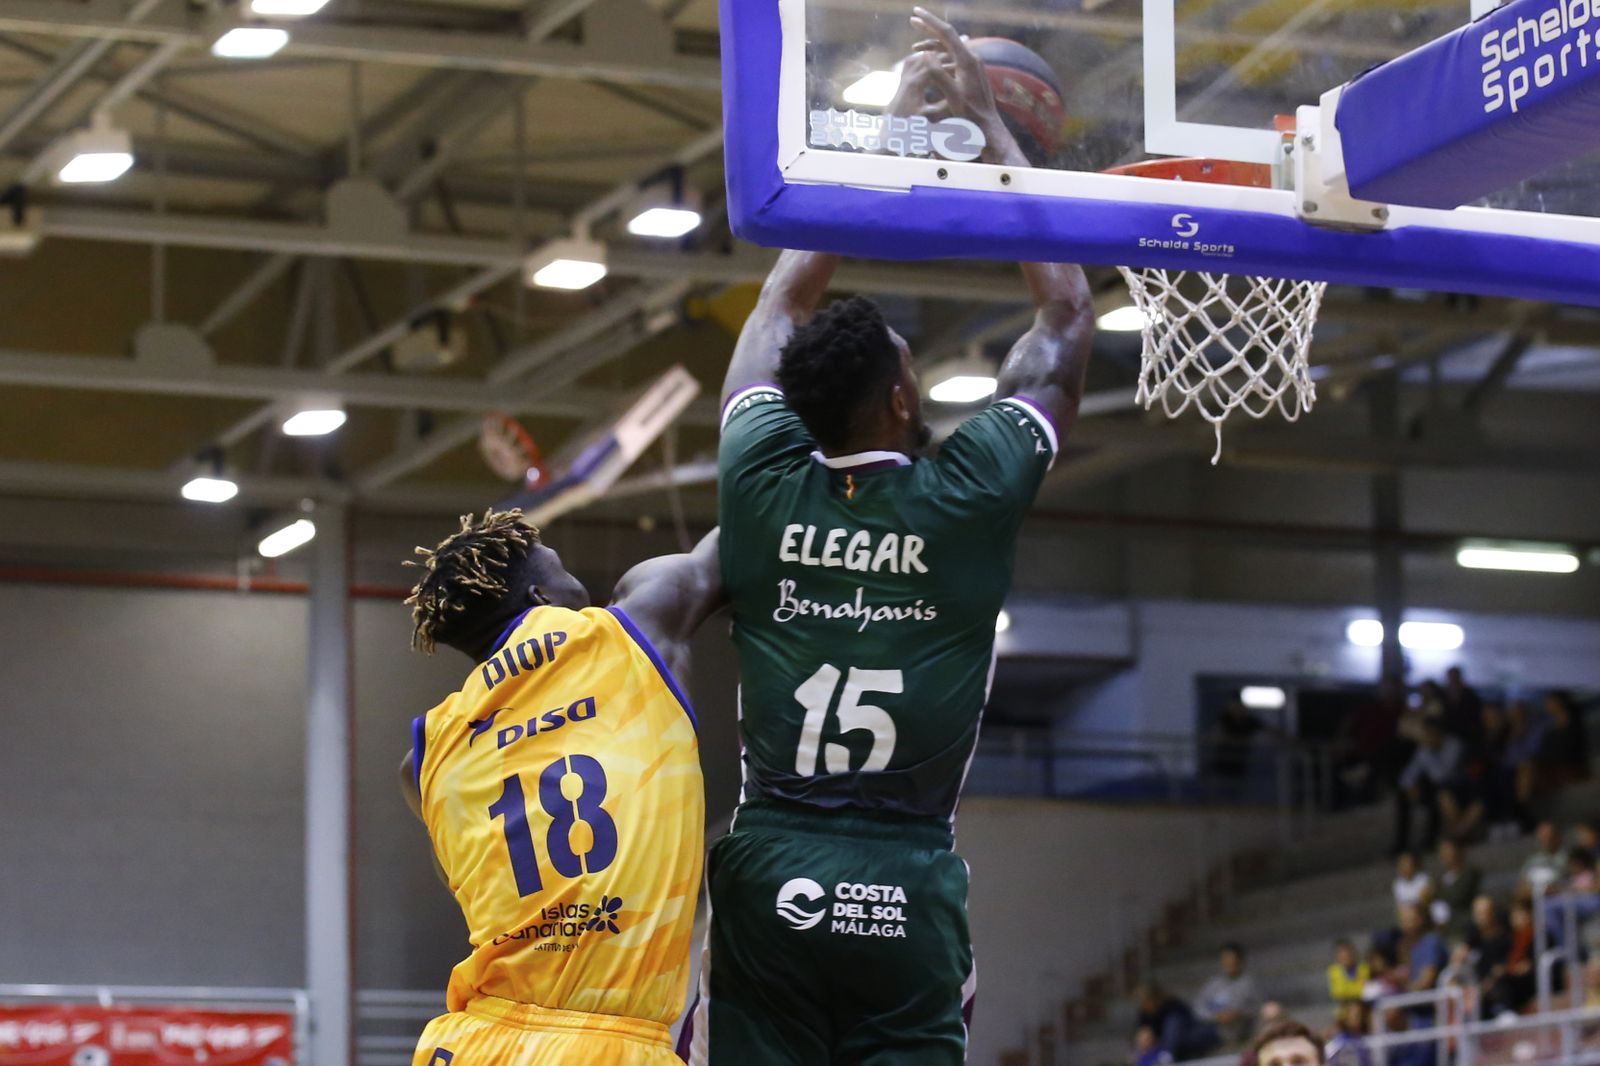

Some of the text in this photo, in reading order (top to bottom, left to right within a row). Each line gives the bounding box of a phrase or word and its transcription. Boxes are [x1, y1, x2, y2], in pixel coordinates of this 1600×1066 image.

[1138, 237, 1235, 253] Schelde Sports
[778, 523, 929, 575] ELEGAR
[482, 631, 567, 690] DIOP
[497, 696, 597, 750] DISA
[794, 663, 904, 777] 15
[488, 754, 618, 898] 18
[835, 882, 908, 903] COSTA
[541, 902, 590, 920] Islas
[832, 919, 906, 938] MÁLAGA
[833, 902, 907, 921] DEL SOL
